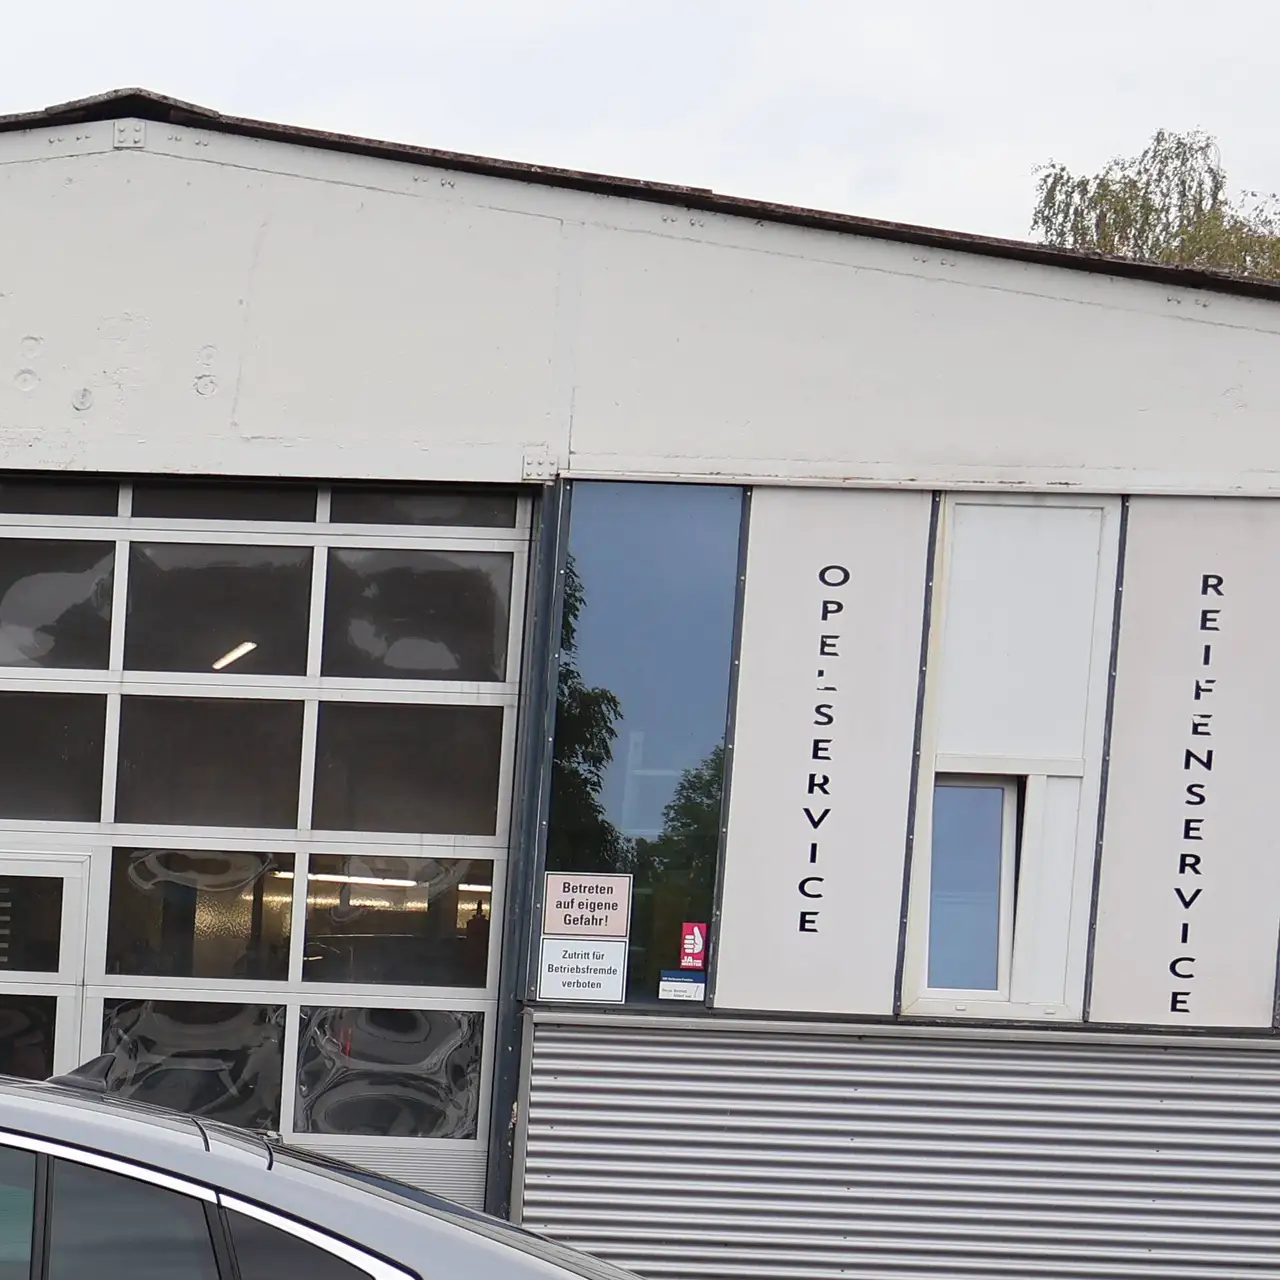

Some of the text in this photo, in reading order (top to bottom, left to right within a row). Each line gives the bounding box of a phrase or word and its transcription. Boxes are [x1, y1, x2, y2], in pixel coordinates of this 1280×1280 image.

[562, 882, 613, 895] Betreten
[555, 898, 618, 912] auf eigene
[563, 913, 608, 926] Gefahr!
[561, 950, 605, 961] Zutritt für
[547, 964, 618, 975] Betriebsfremde
[561, 979, 602, 989] verboten
